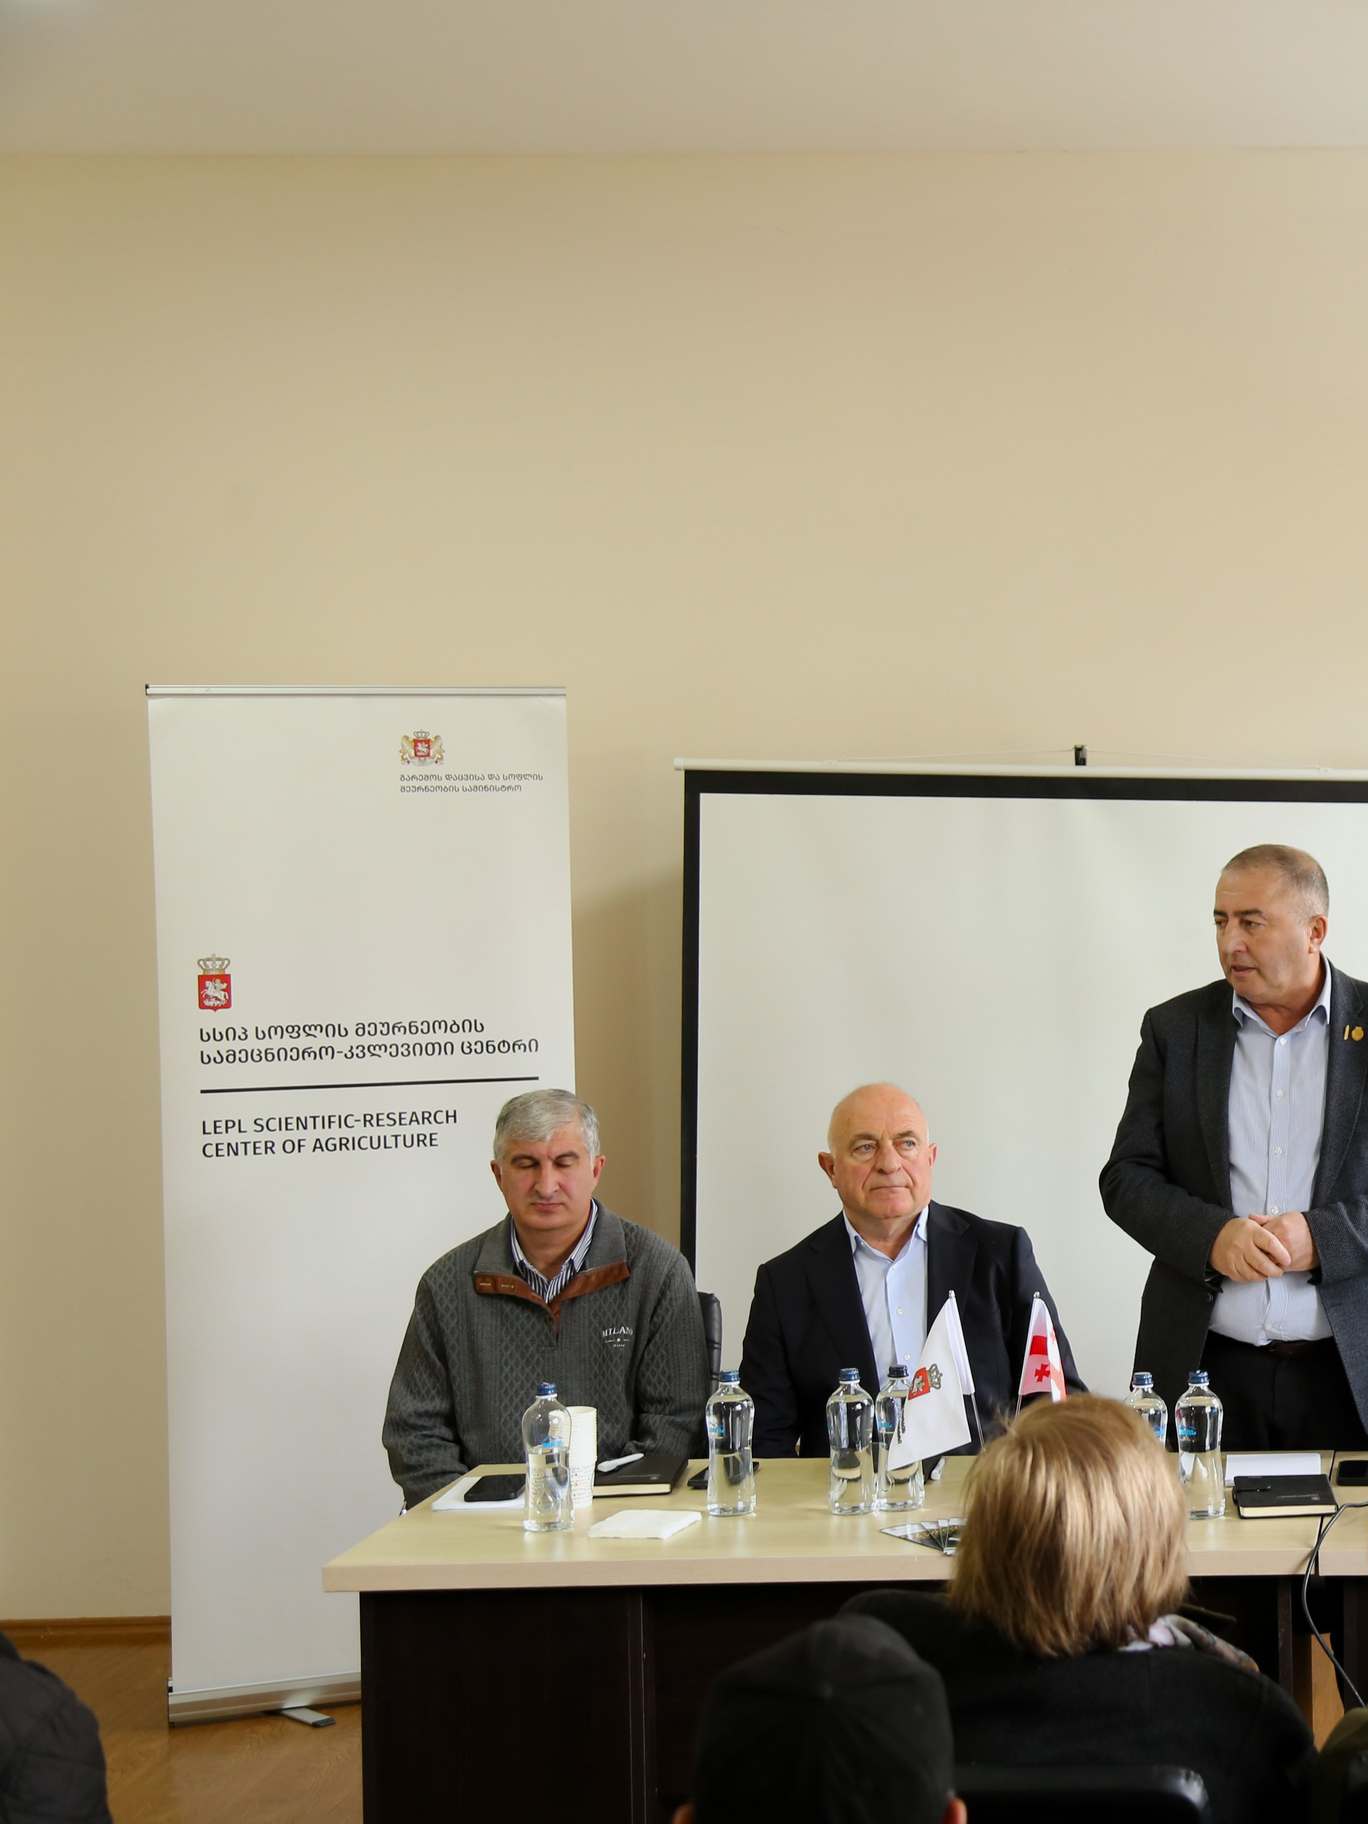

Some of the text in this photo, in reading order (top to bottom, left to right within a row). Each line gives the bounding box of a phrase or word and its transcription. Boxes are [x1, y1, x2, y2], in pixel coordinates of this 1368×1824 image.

[199, 1019, 485, 1043] სსიპ სოფლის მეურნეობის
[199, 1039, 539, 1065] სამეცნიერო-კვლევითი ცენტრი
[202, 1110, 458, 1135] LEPL SCIENTIFIC-RESEARCH
[202, 1133, 439, 1158] CENTER OF AGRICULTURE
